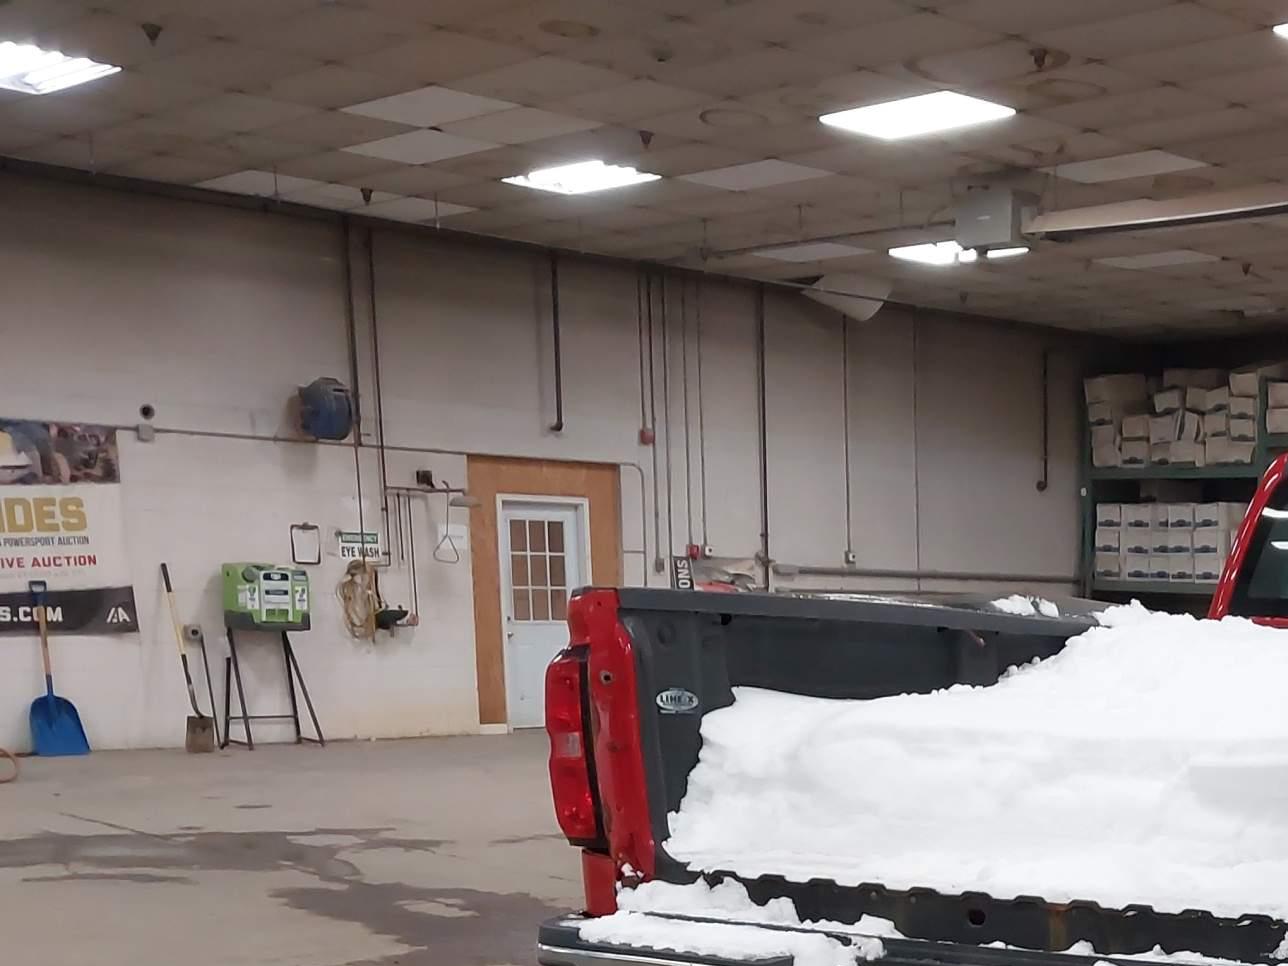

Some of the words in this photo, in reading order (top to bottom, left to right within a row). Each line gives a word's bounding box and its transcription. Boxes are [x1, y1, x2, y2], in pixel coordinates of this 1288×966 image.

[58, 535, 89, 545] AUCTION
[341, 546, 356, 557] EYE
[32, 554, 97, 567] AUCTION
